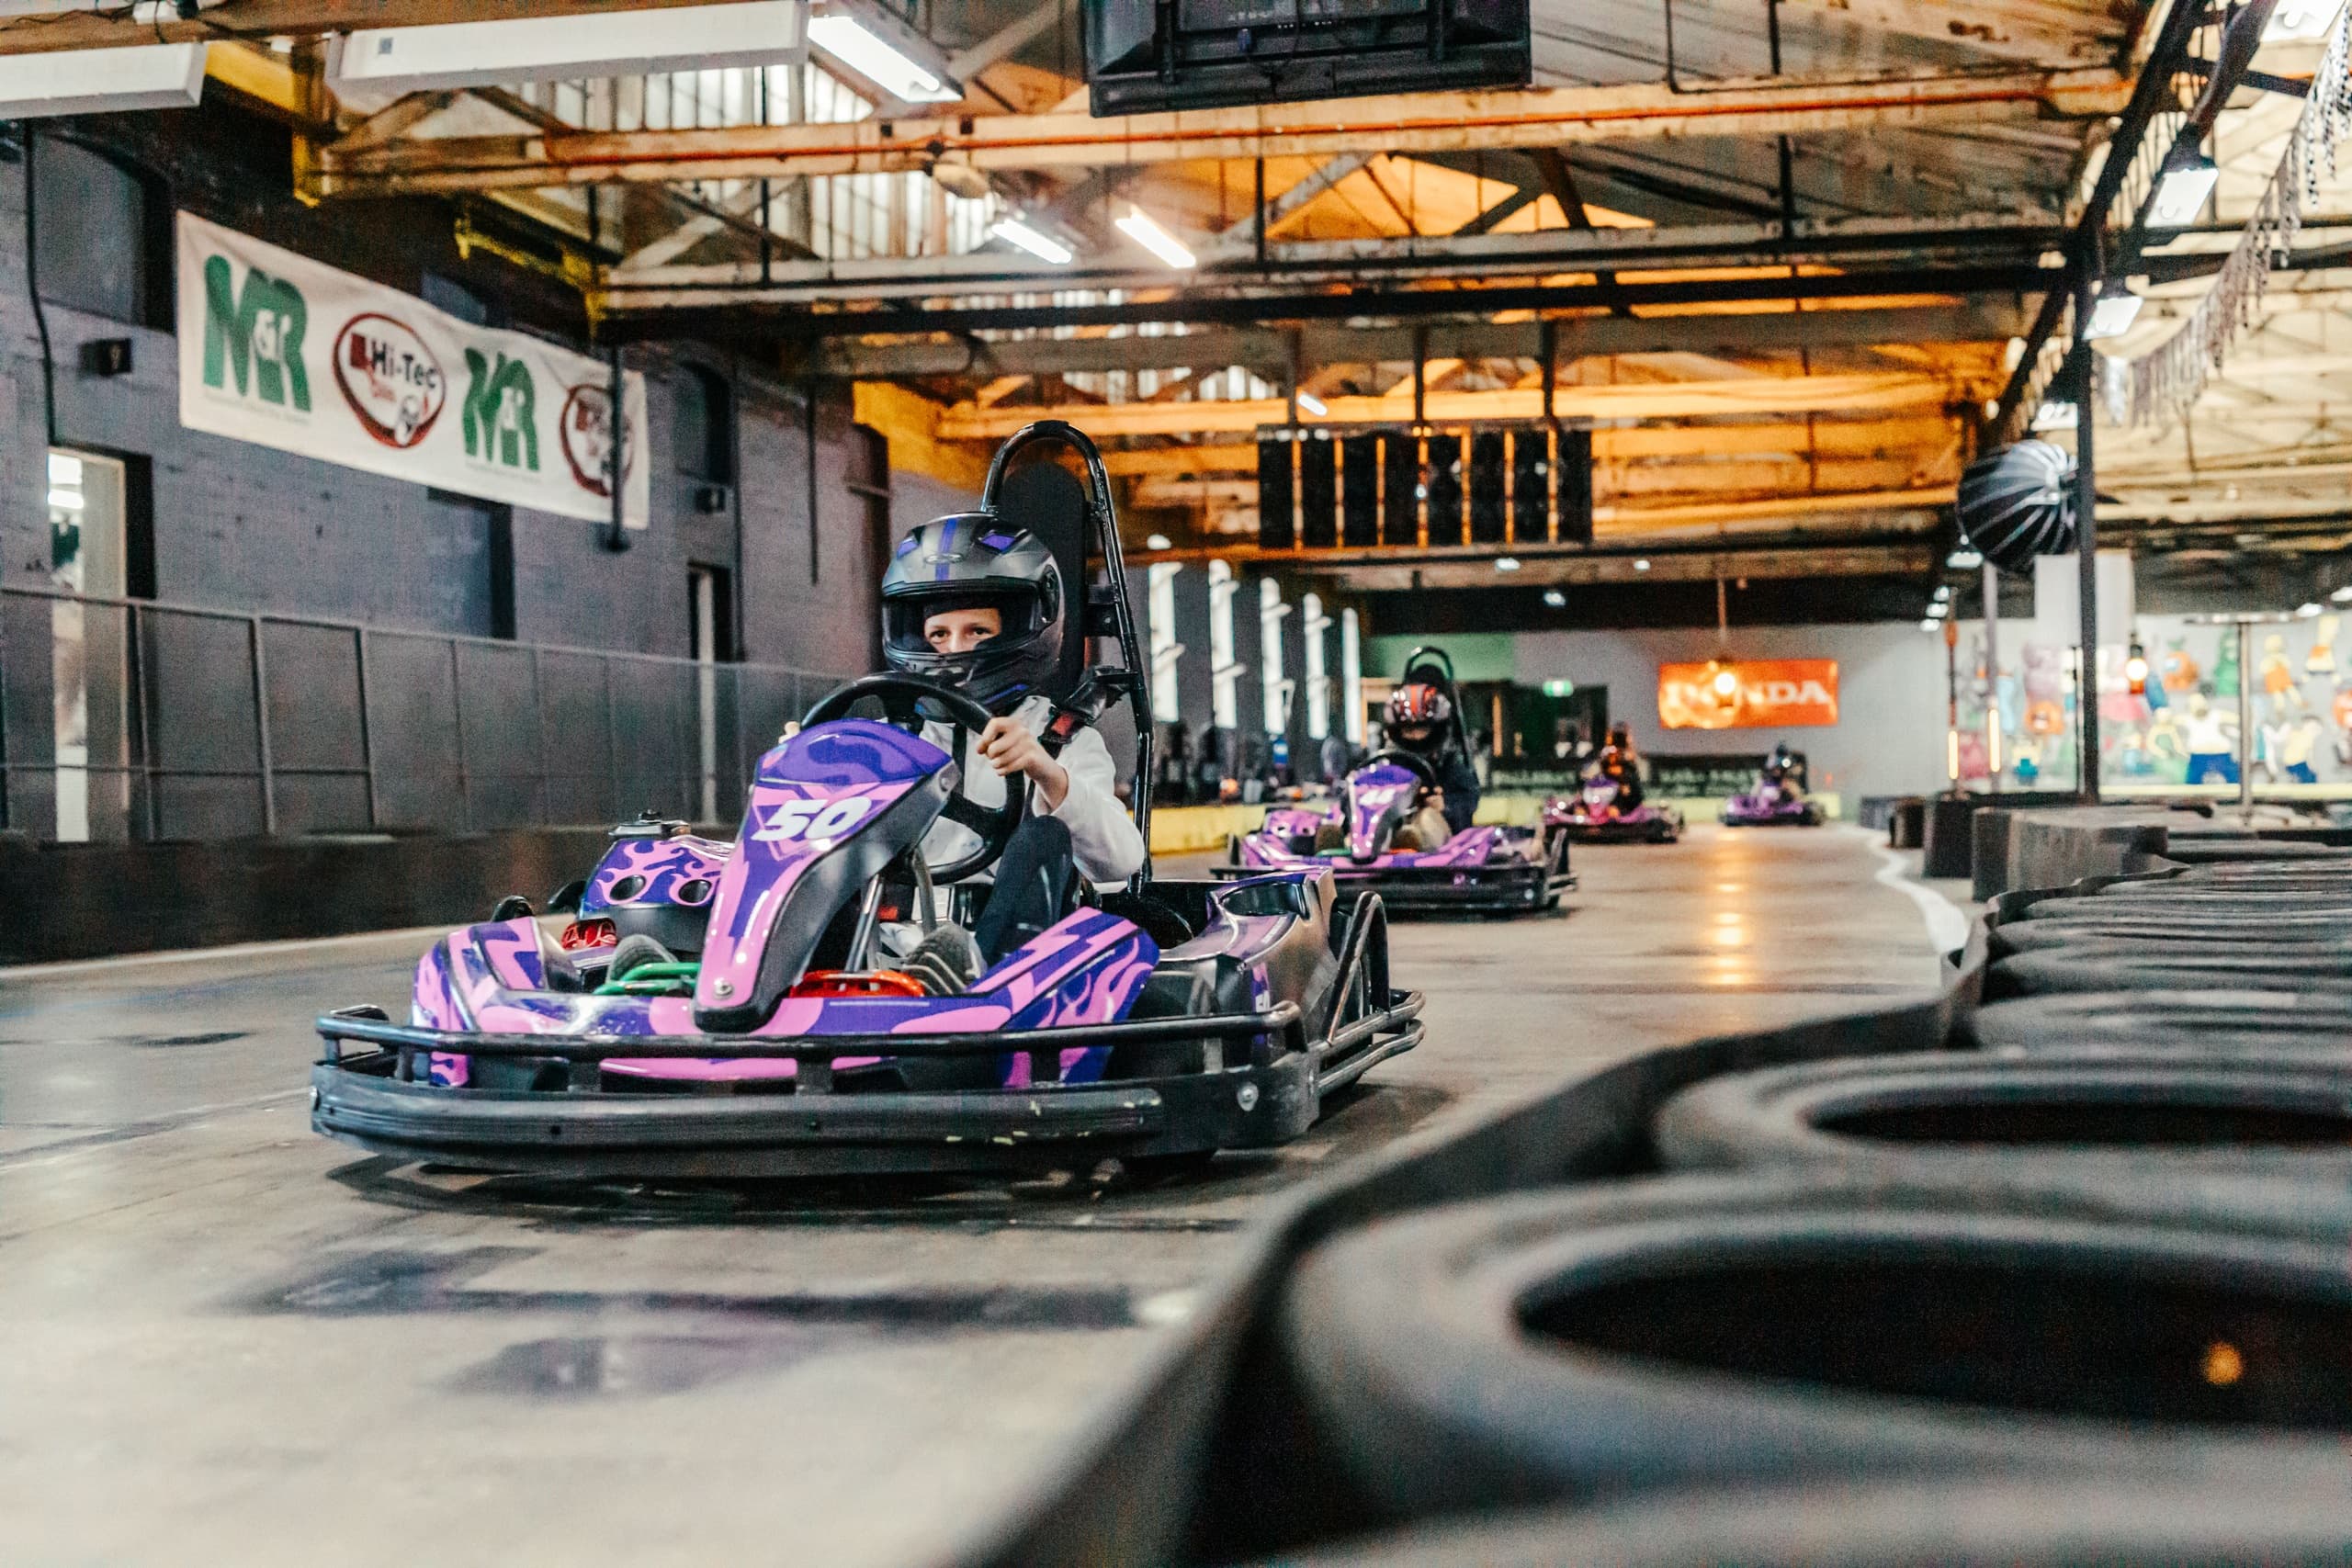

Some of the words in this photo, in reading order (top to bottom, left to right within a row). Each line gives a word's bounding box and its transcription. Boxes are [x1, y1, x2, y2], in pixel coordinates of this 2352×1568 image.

[370, 336, 437, 389] Hi-Tec
[1665, 680, 1831, 706] HNDA
[751, 796, 873, 841] 50
